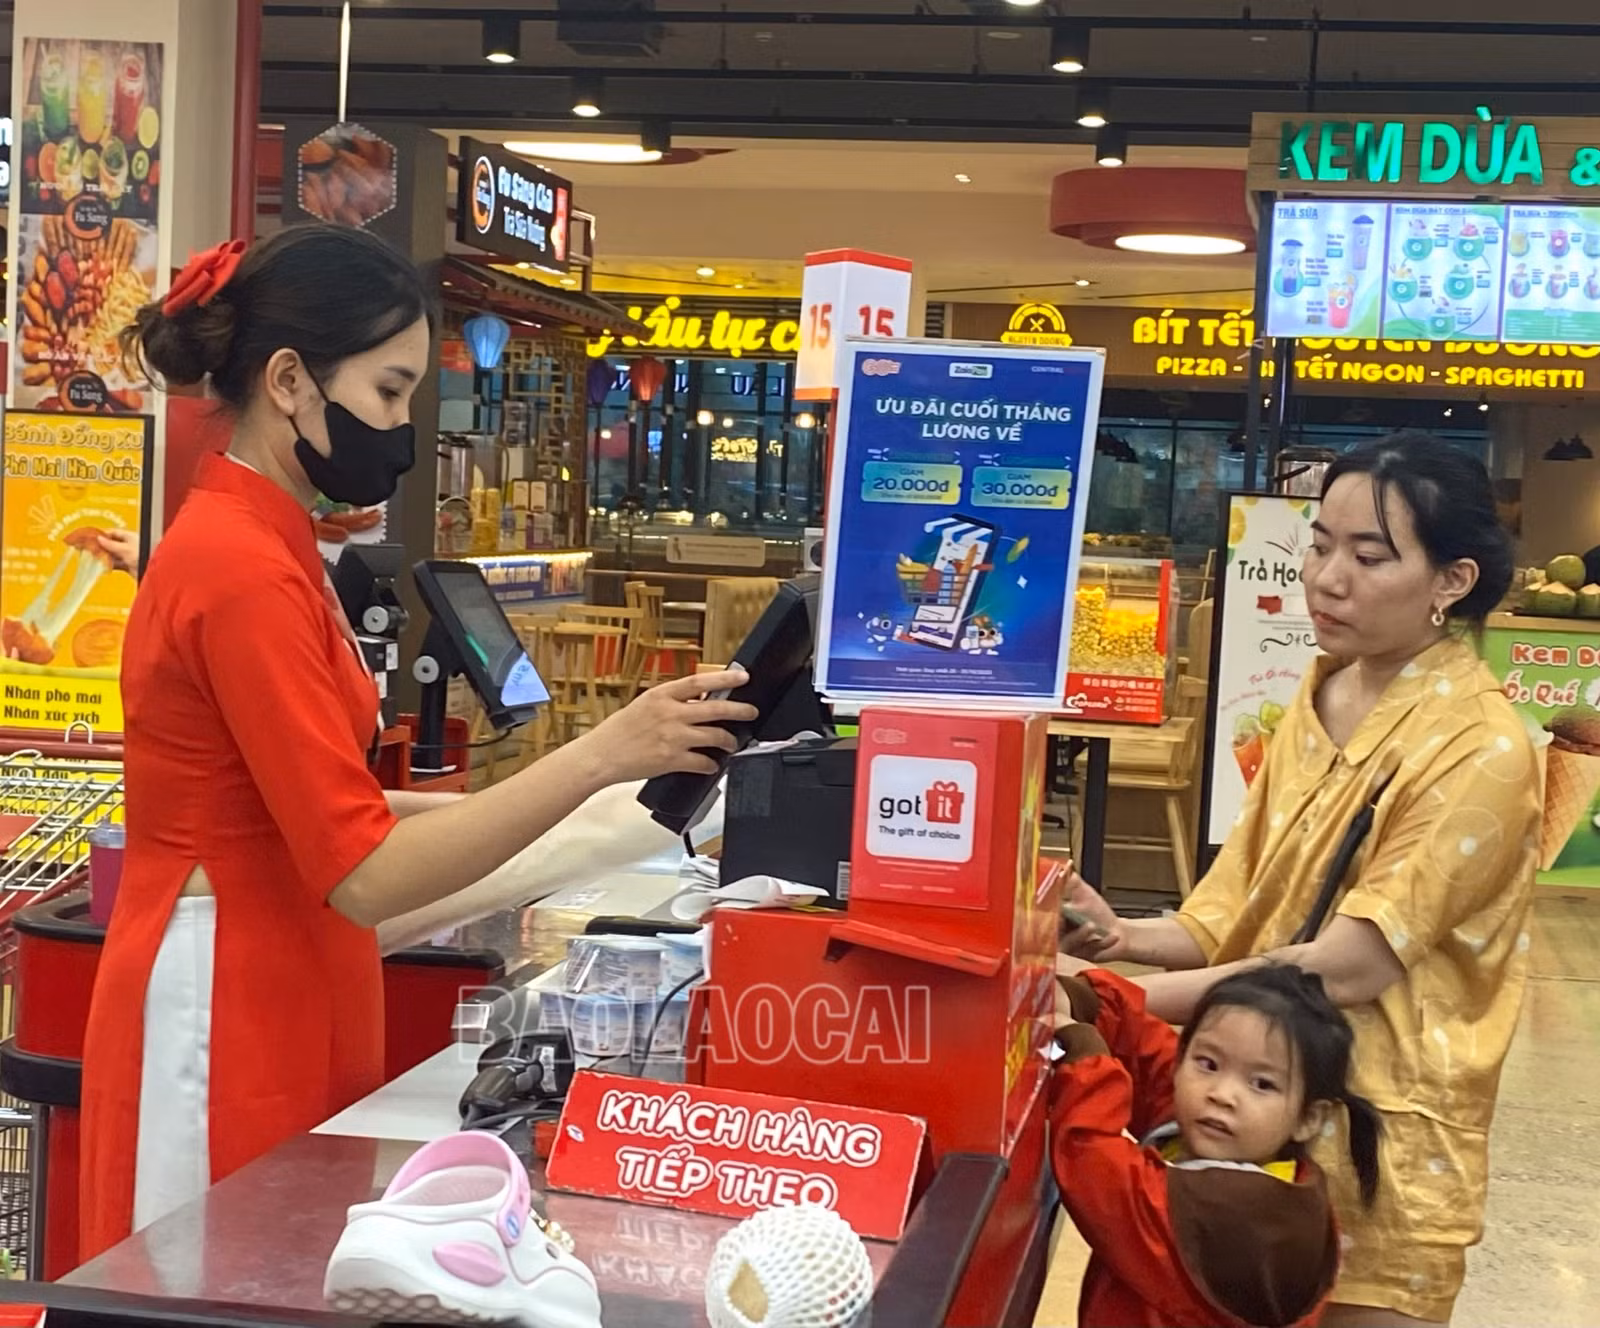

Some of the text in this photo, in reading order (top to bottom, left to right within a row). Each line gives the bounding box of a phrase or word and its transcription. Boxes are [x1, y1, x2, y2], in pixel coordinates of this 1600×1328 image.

[1280, 121, 1405, 182] KEM
[1419, 106, 1544, 185] DỪA
[770, 320, 802, 353] c
[810, 302, 834, 350] 15
[858, 303, 896, 337] 15
[1133, 309, 1191, 345] BÍT
[1156, 356, 1227, 375] PIZZA
[1294, 353, 1338, 380] TẾT
[1342, 361, 1425, 383] NGON
[1444, 366, 1585, 389] SPAGHETTI
[876, 397, 1072, 422] ƯU ĐÃI CUỐI THÁNG
[921, 421, 1023, 442] LƯƠNG VỀ
[32, 455, 63, 479] Mai
[1273, 562, 1304, 588] Ho
[1512, 643, 1600, 667] Kem D
[879, 794, 954, 819] got it
[878, 824, 961, 841] The gift of choice
[598, 1090, 883, 1168] KHÁCH HÀNG
[616, 1144, 839, 1208] TIẾP THEO
